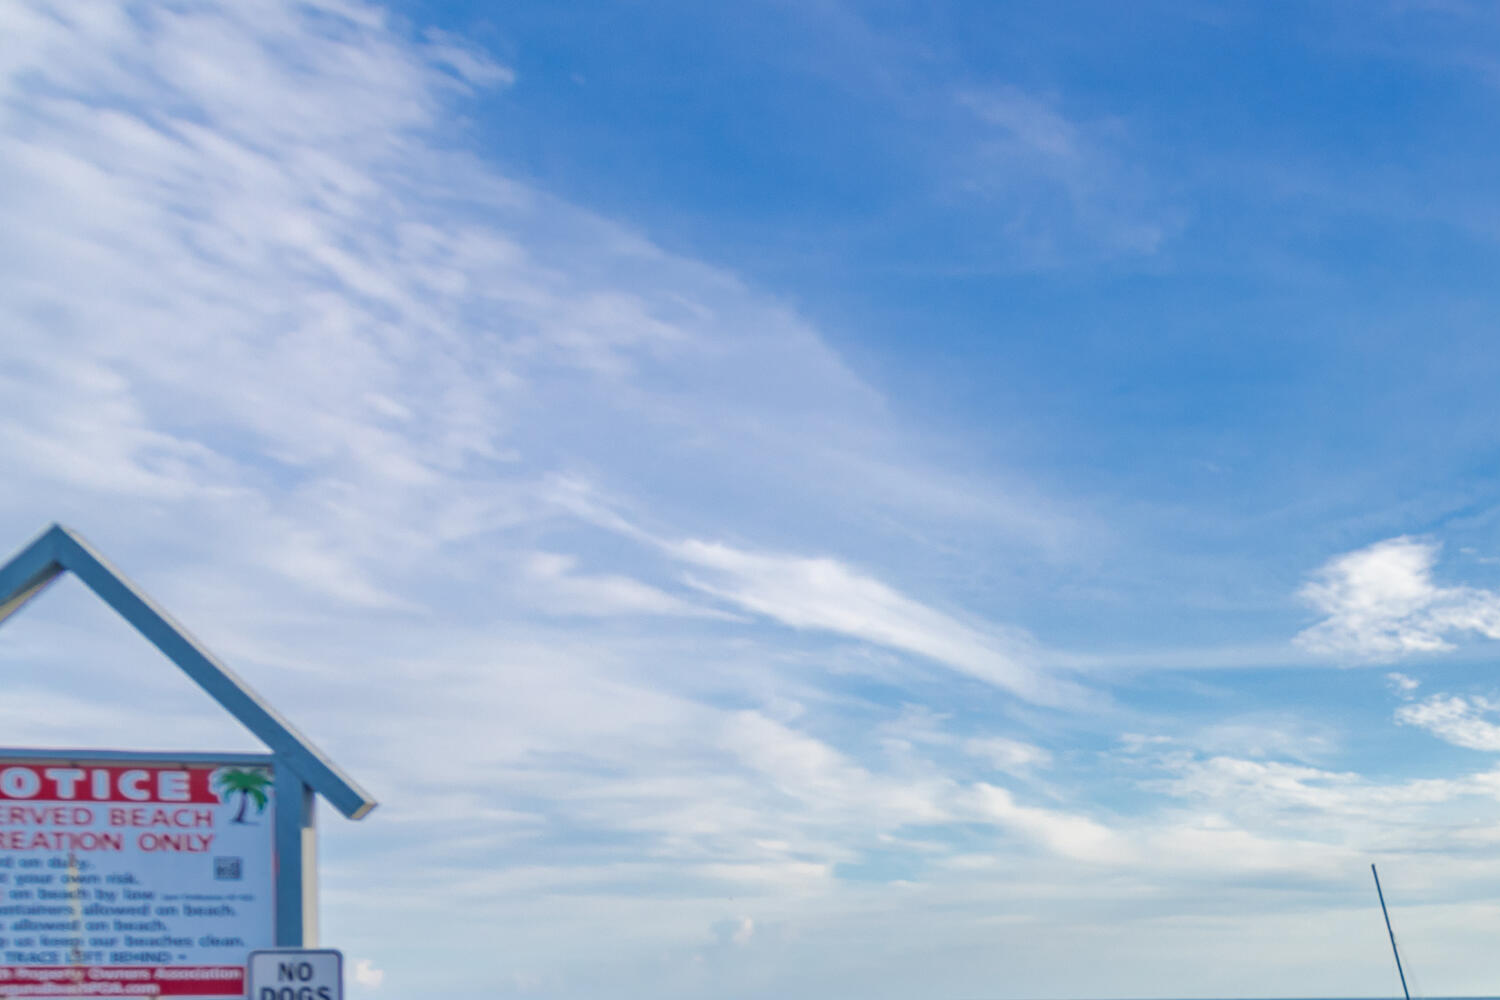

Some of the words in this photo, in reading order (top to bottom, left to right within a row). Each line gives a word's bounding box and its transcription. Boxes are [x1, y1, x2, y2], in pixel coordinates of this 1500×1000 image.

[0, 766, 192, 802] OTICE
[108, 807, 214, 828] BEACH
[137, 832, 215, 853] ONLY
[18, 857, 42, 869] on
[47, 855, 95, 872] duy.
[14, 873, 54, 887] your
[59, 873, 101, 885] own
[8, 889, 33, 900] on
[94, 887, 117, 902] by
[82, 902, 151, 916] allowed
[154, 905, 180, 916] on
[182, 903, 236, 917] beach.
[85, 921, 110, 931] on
[113, 919, 168, 932] beach.
[88, 936, 119, 947] our
[124, 934, 195, 948] beaches
[197, 934, 246, 948] clean.
[4, 950, 60, 963] TRACE
[110, 951, 173, 963] BEHIND
[87, 968, 152, 981] Owners
[154, 968, 242, 980] Association
[278, 961, 314, 982] NO
